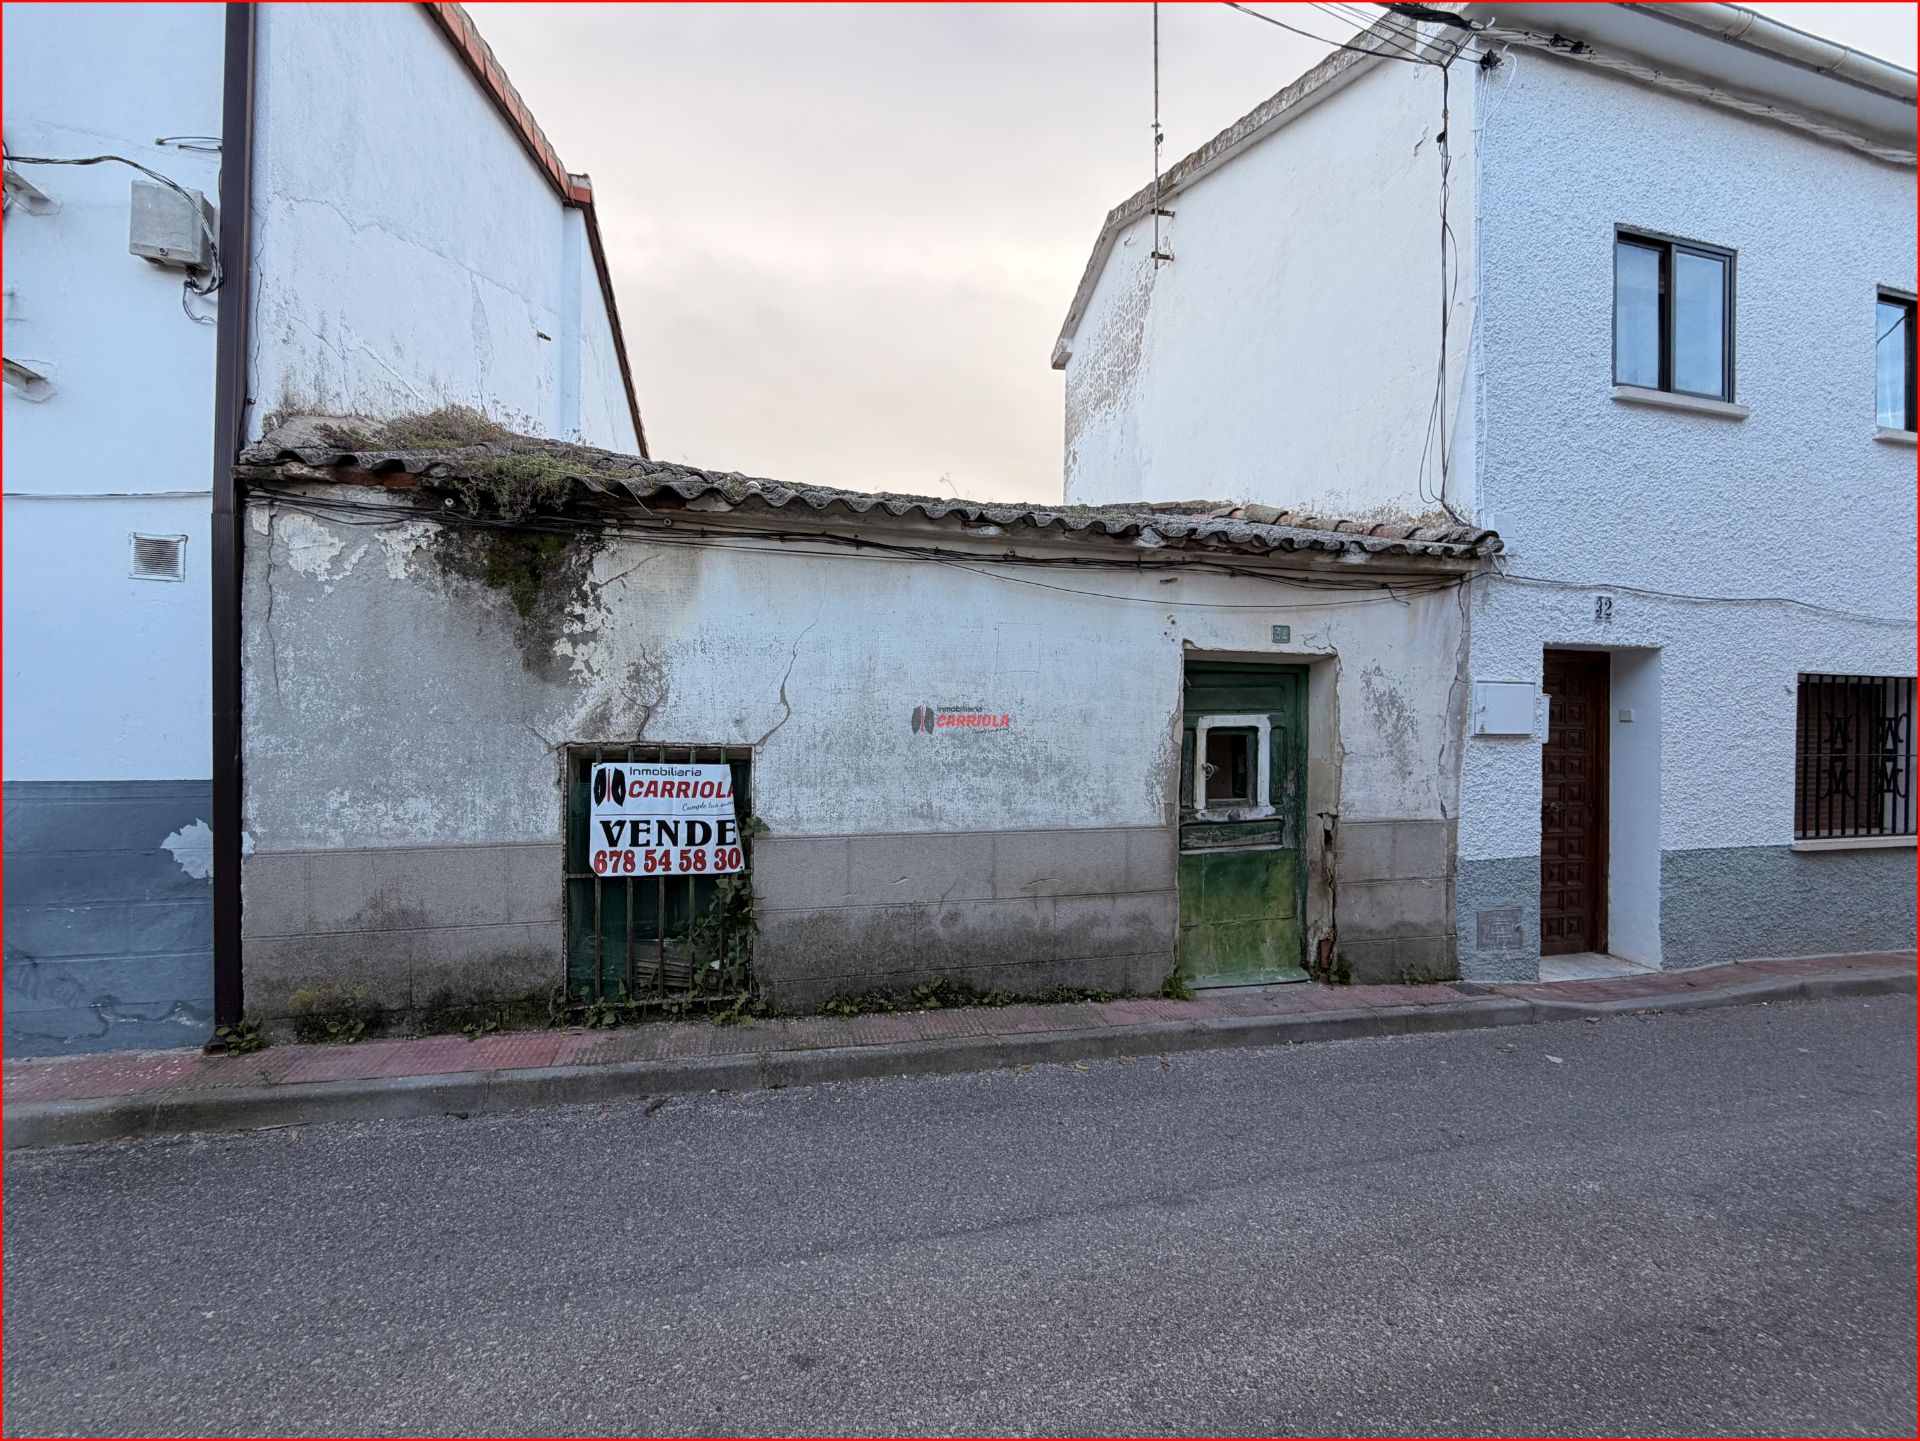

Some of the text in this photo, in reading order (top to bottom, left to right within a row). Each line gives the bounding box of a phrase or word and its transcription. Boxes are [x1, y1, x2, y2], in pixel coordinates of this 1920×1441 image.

[1595, 599, 1612, 616] 32
[629, 766, 702, 777] Inmobiliaria
[599, 819, 737, 848] VENDE
[593, 847, 741, 874] 678 54 58 30
